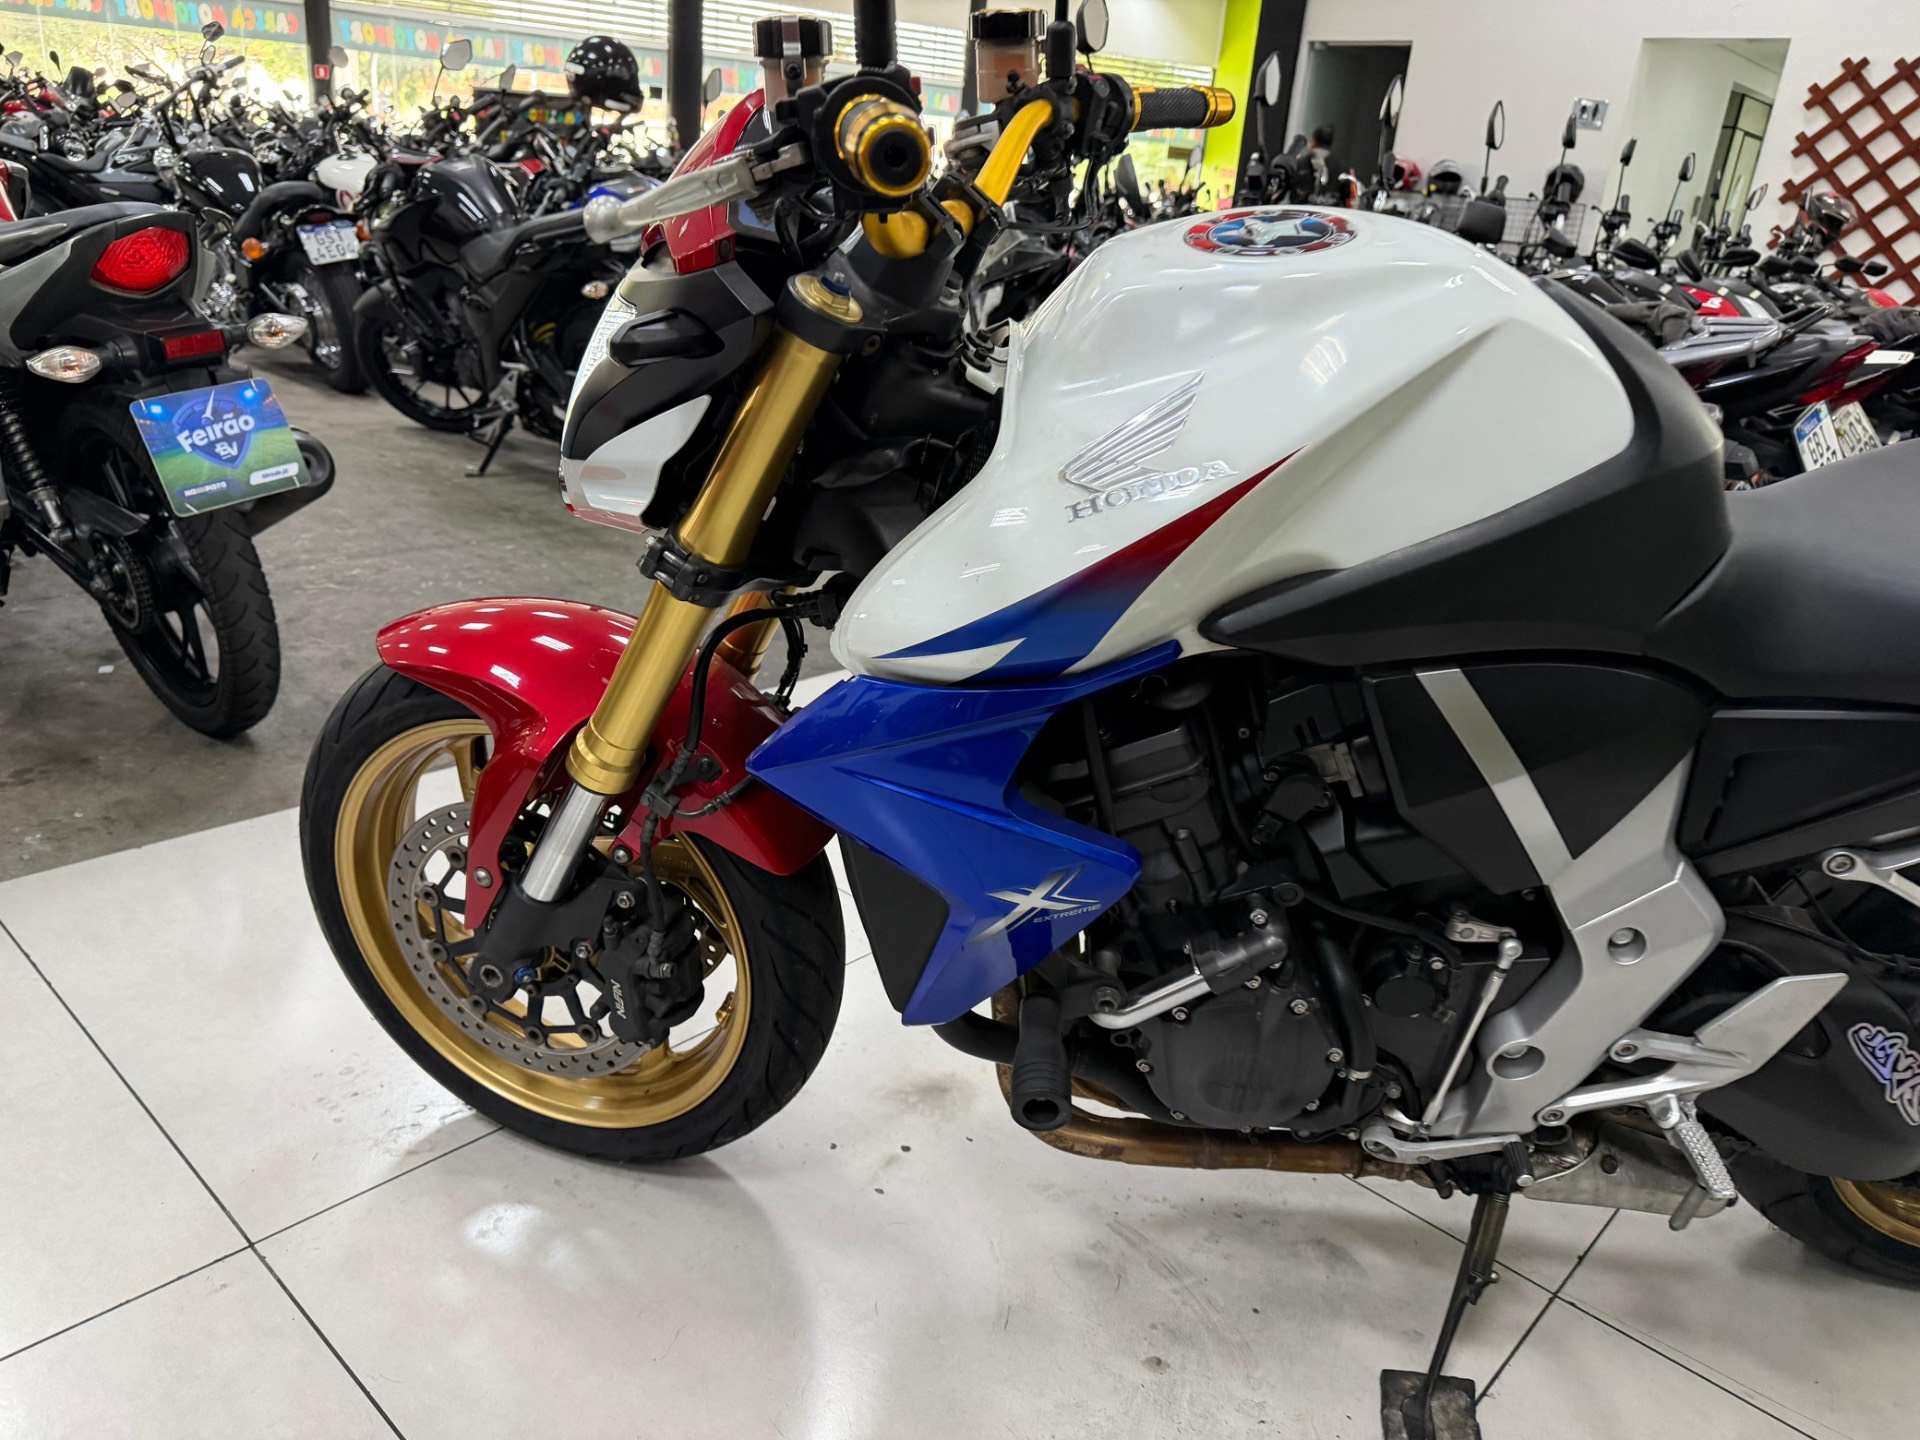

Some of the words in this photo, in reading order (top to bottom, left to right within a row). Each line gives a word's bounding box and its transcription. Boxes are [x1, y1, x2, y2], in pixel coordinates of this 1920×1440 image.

[176, 412, 255, 453] Feirão
[1064, 459, 1239, 523] HONDA
[1033, 904, 1102, 924] EXTREME
